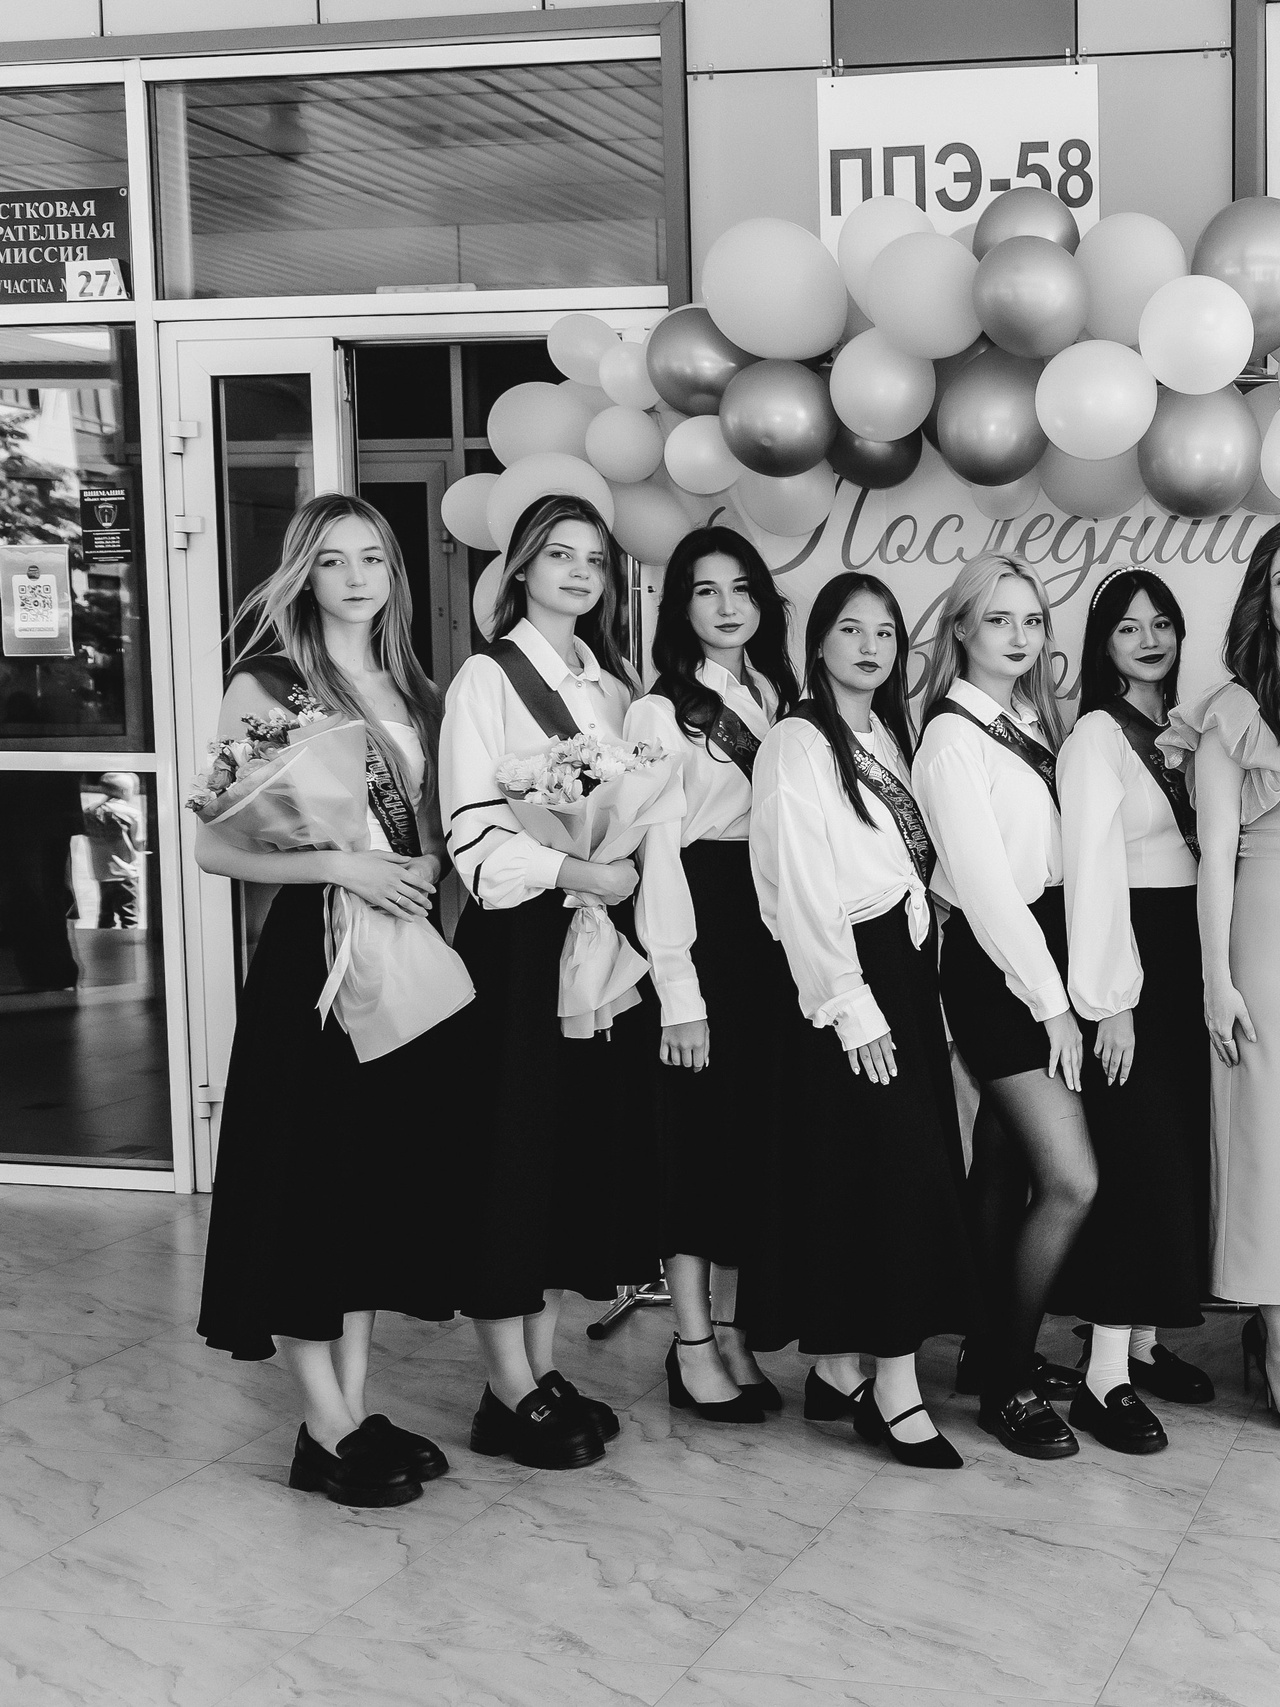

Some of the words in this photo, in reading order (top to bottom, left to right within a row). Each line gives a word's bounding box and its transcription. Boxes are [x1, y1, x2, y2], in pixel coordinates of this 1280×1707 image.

[829, 138, 1094, 216] ППЭ-58
[0, 222, 116, 243] АТЕЛЬНАЯ
[0, 278, 55, 294] ЧАСТКА
[77, 270, 123, 298] 27
